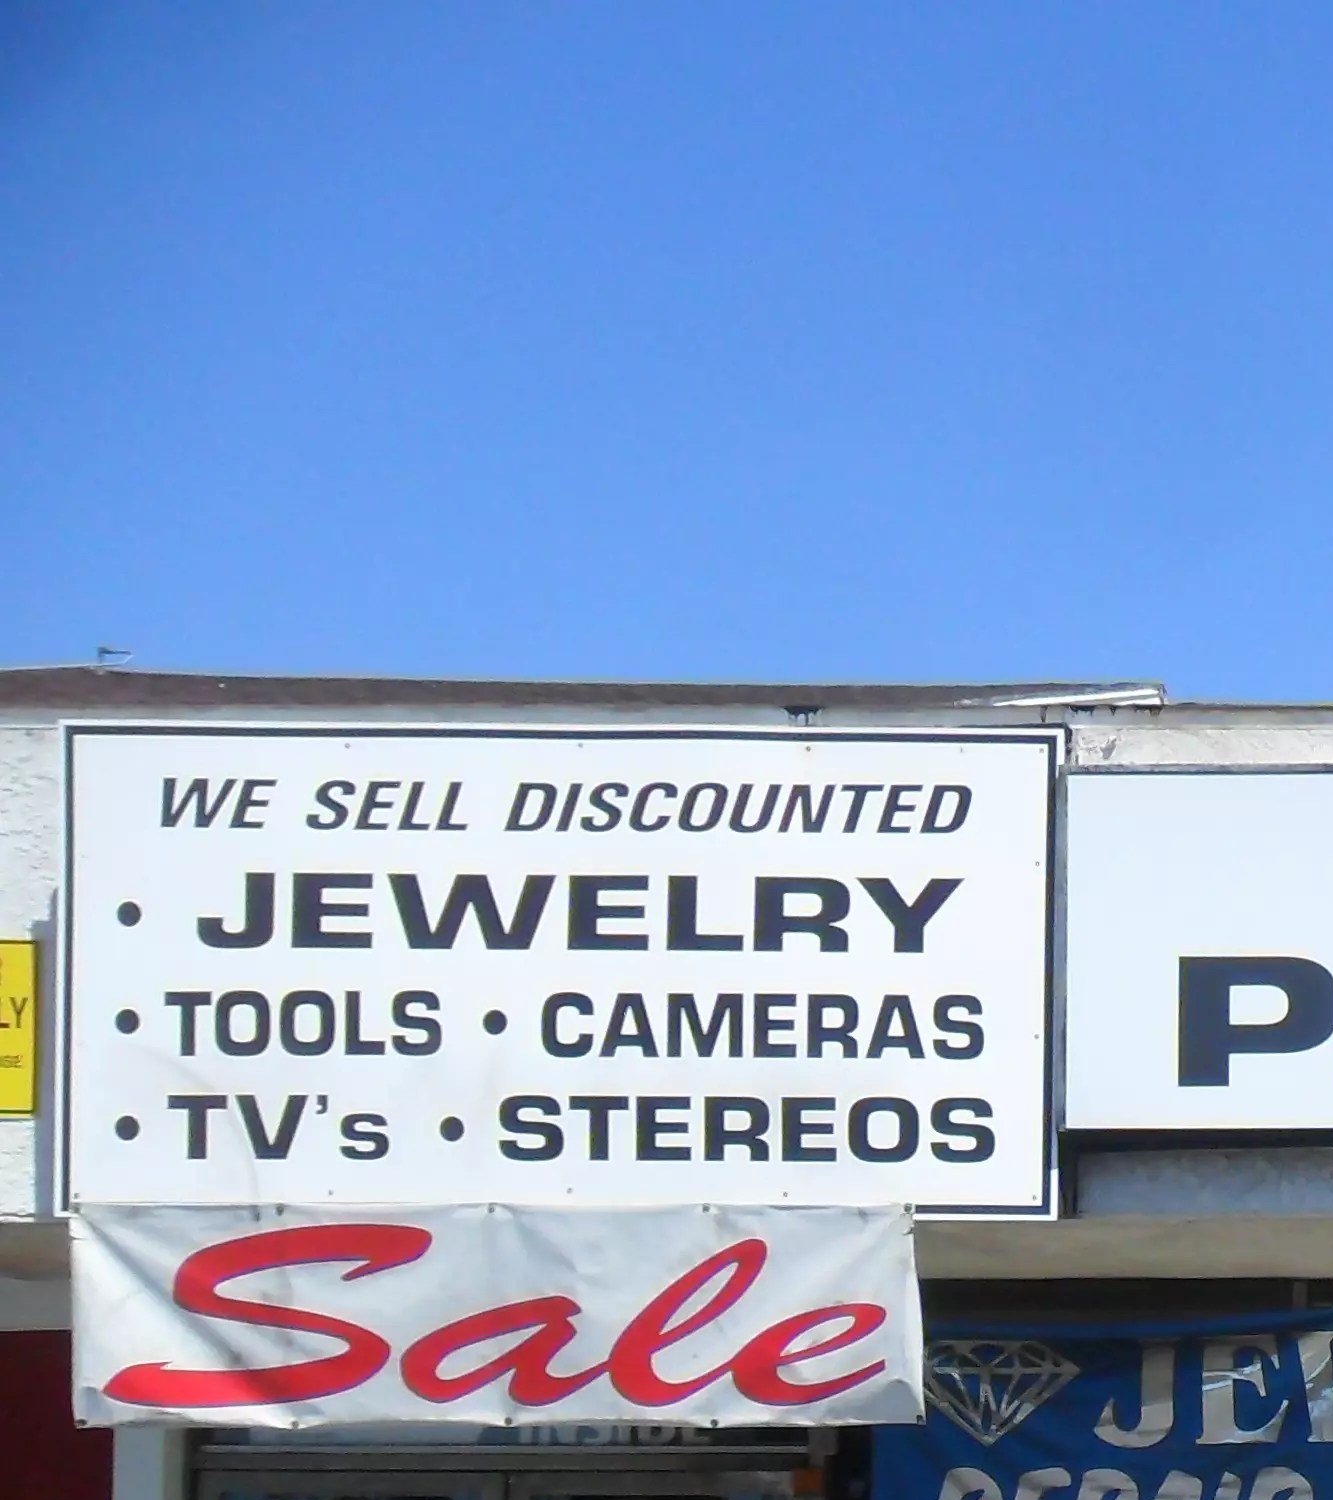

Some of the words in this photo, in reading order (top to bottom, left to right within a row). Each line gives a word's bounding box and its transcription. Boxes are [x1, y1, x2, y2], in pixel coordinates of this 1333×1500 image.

[160, 777, 277, 829] WE
[307, 780, 469, 833] SELL
[505, 782, 973, 836] DISCOUNTED
[197, 872, 964, 953] JEWELRY
[163, 990, 443, 1057] TOOLS
[540, 992, 985, 1060] CAMERAS
[167, 1094, 389, 1161] TV's
[498, 1096, 997, 1163] STEREOS
[101, 1223, 887, 1409] Sale
